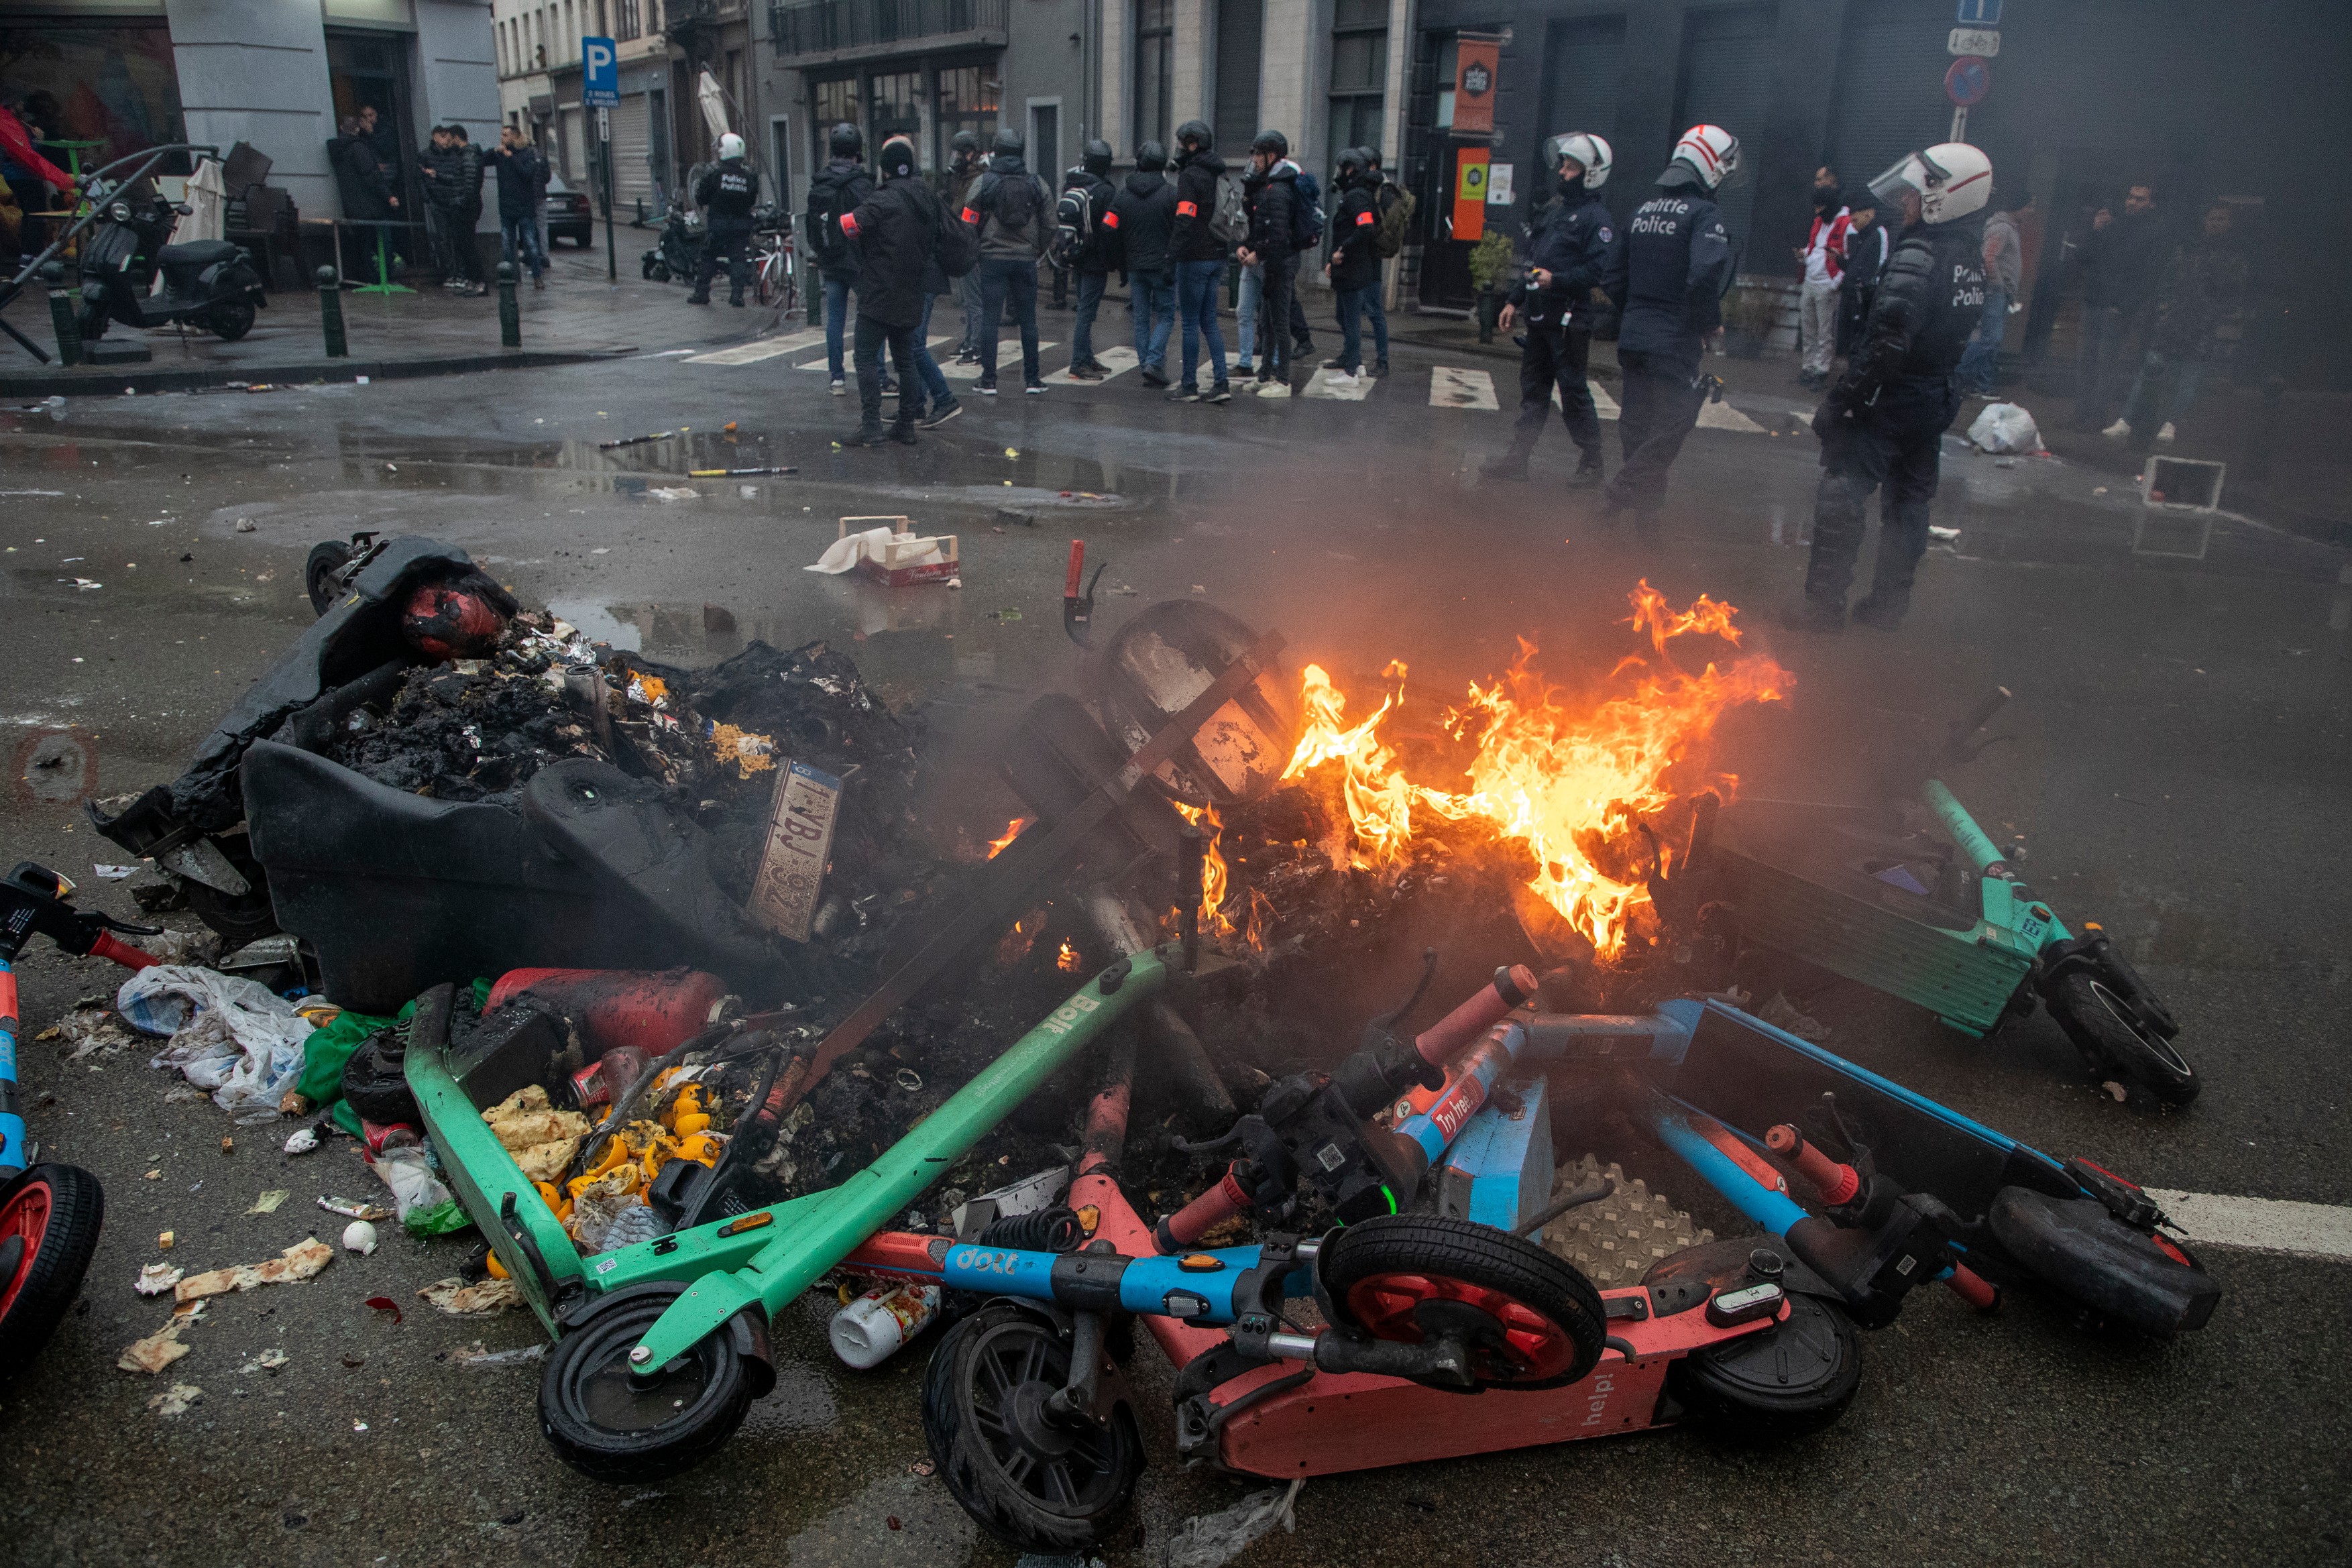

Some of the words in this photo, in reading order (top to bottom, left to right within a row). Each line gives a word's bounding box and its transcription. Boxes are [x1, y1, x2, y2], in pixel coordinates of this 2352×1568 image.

[587, 44, 612, 80] P
[722, 174, 746, 184] Police
[1637, 199, 1689, 214] Politie
[1631, 215, 1677, 235] Police
[2019, 917, 2043, 939] IER
[1042, 994, 1101, 1033] Bolt
[1436, 1111, 1457, 1133] Try
[1581, 1374, 1614, 1426] help!
